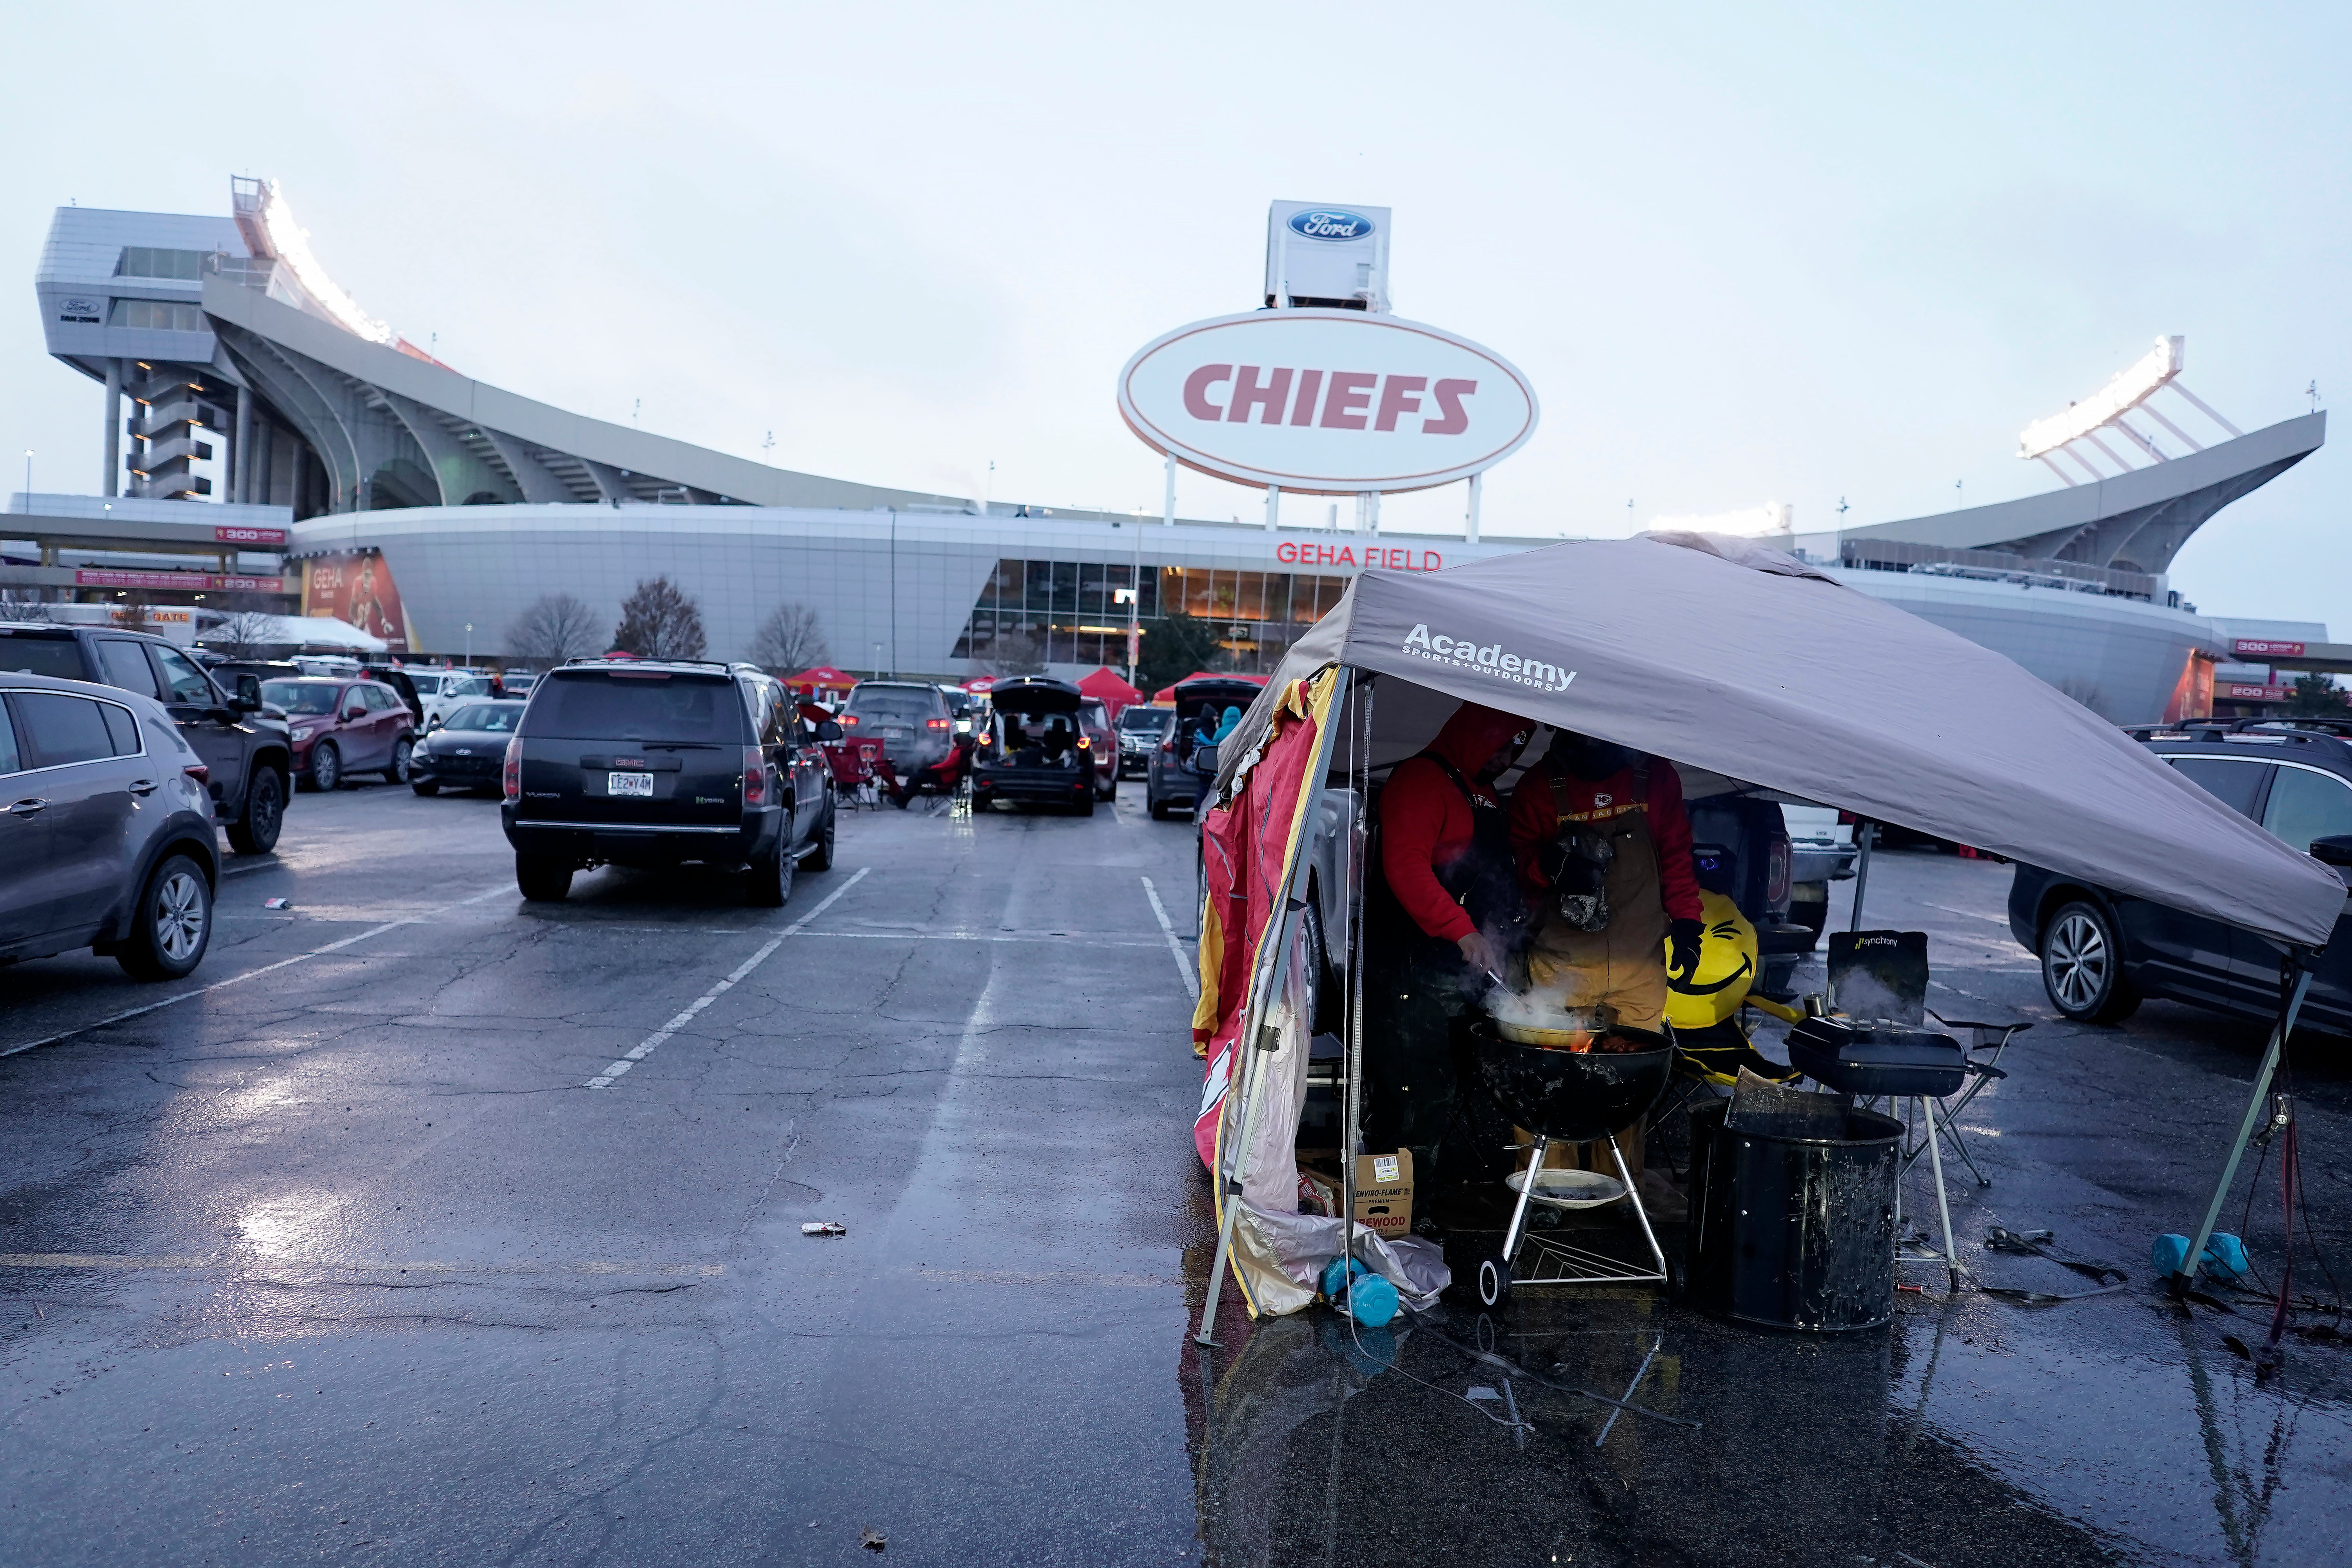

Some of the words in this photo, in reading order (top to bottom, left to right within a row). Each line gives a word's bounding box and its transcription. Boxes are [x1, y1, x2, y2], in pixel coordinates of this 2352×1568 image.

[1303, 212, 1359, 237] Ford
[1183, 363, 1477, 436] CHIEFS
[1276, 542, 1356, 567] GEHA
[1365, 547, 1443, 571] FIELD
[314, 568, 343, 589] GEHA
[1403, 623, 1577, 692] Academy
[1574, 809, 1612, 821] ANSAS
[1864, 936, 1898, 947] synchrony
[1355, 1188, 1403, 1198] ENVIRO-FLAME
[1355, 1216, 1406, 1227] REWOOD
